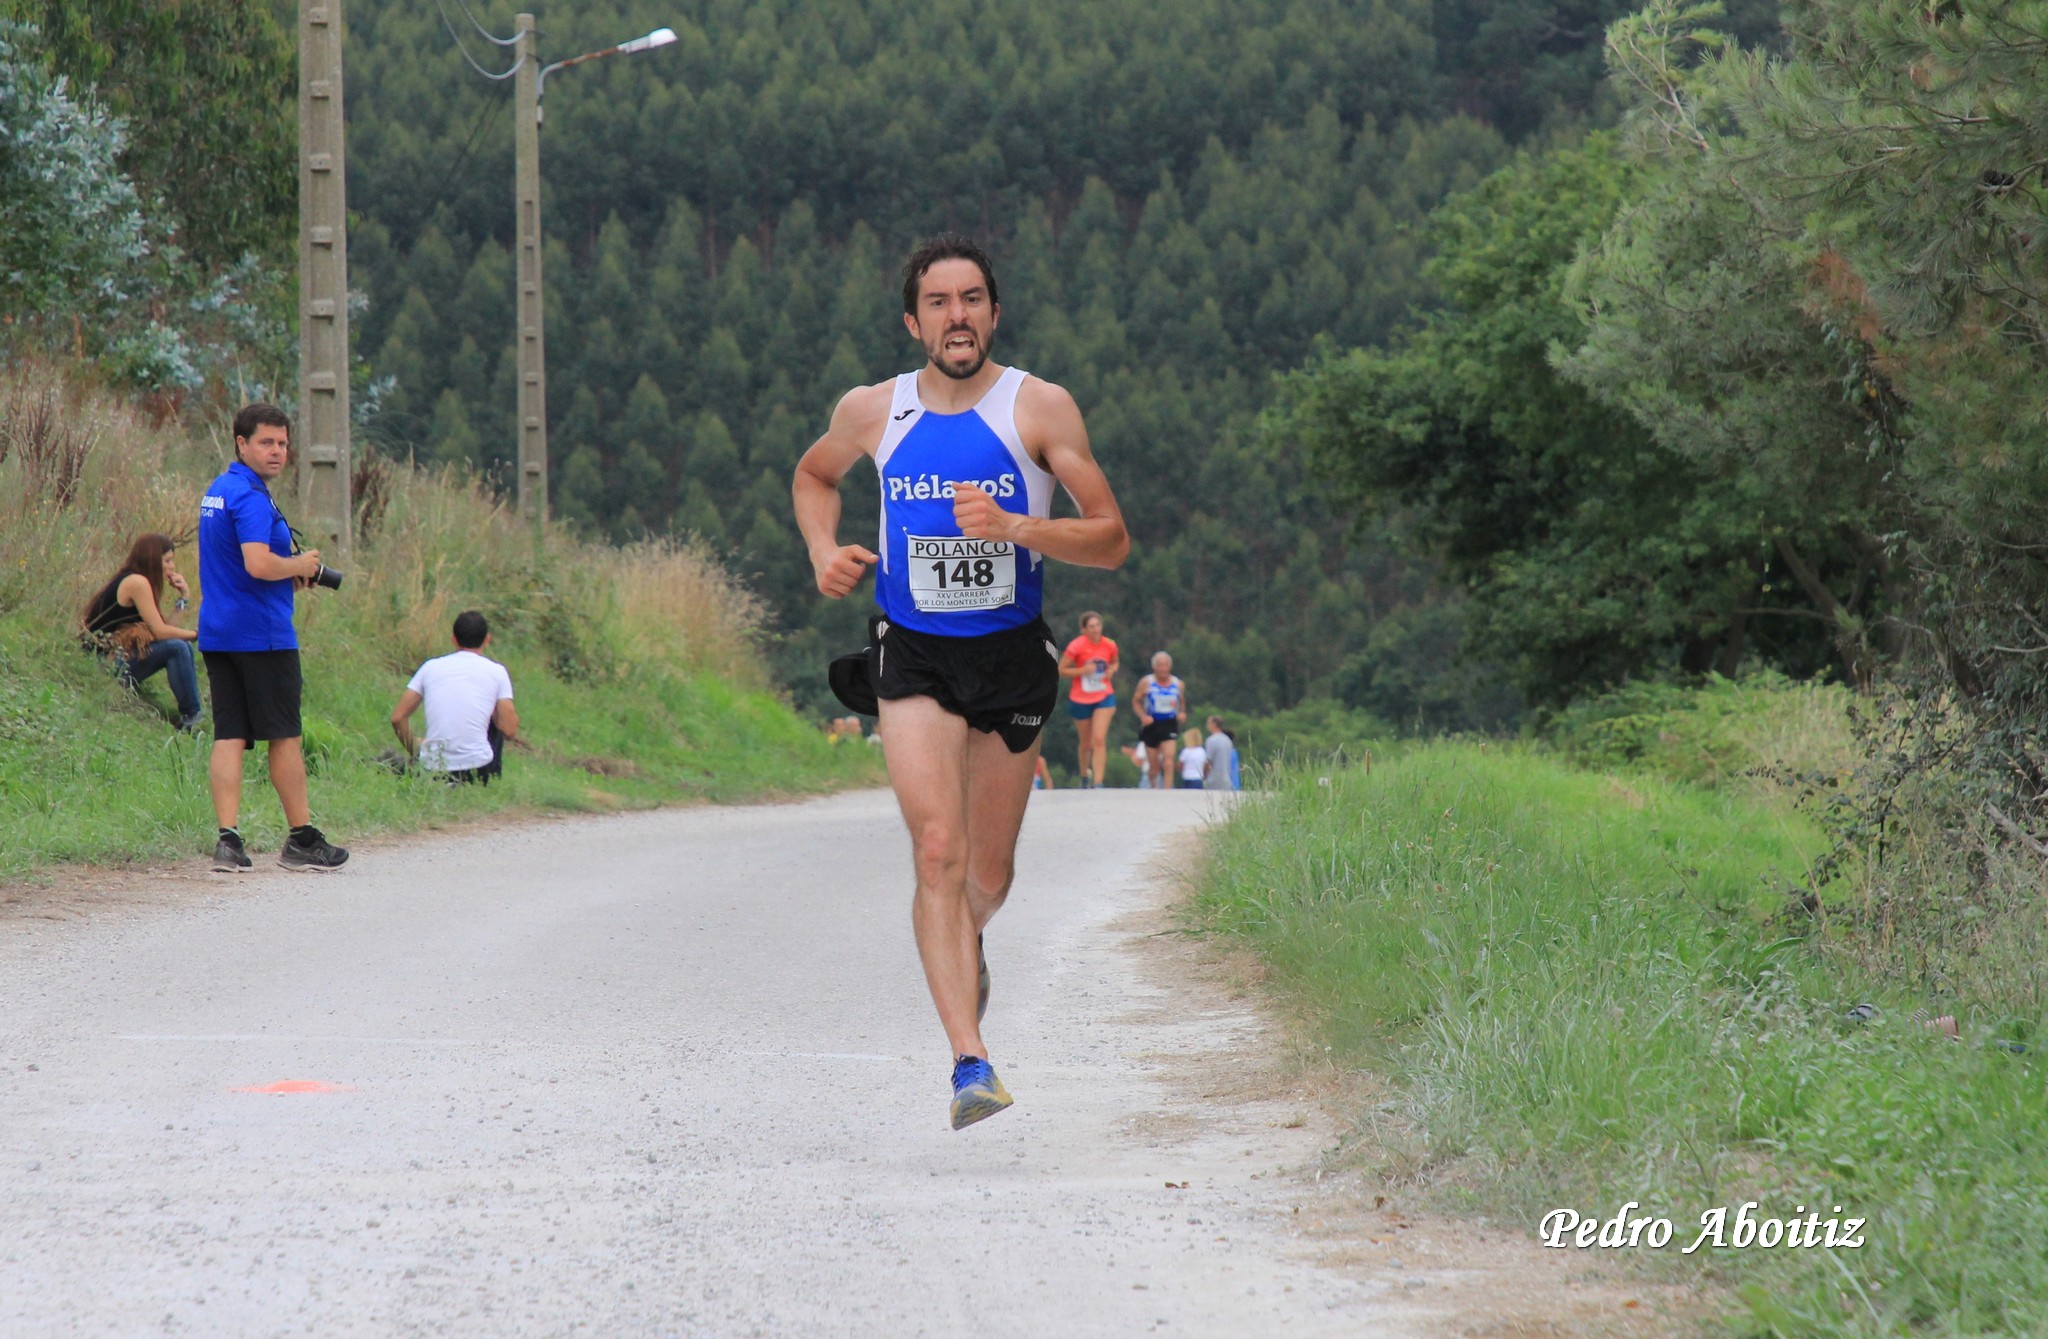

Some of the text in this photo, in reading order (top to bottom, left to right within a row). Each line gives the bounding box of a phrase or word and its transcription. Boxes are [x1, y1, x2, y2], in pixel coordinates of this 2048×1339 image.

[887, 473, 1015, 501] PiélaoS
[915, 541, 1008, 556] POLANCO
[931, 559, 994, 589] 148
[953, 590, 990, 599] CARRERA
[946, 598, 978, 607] MONTES
